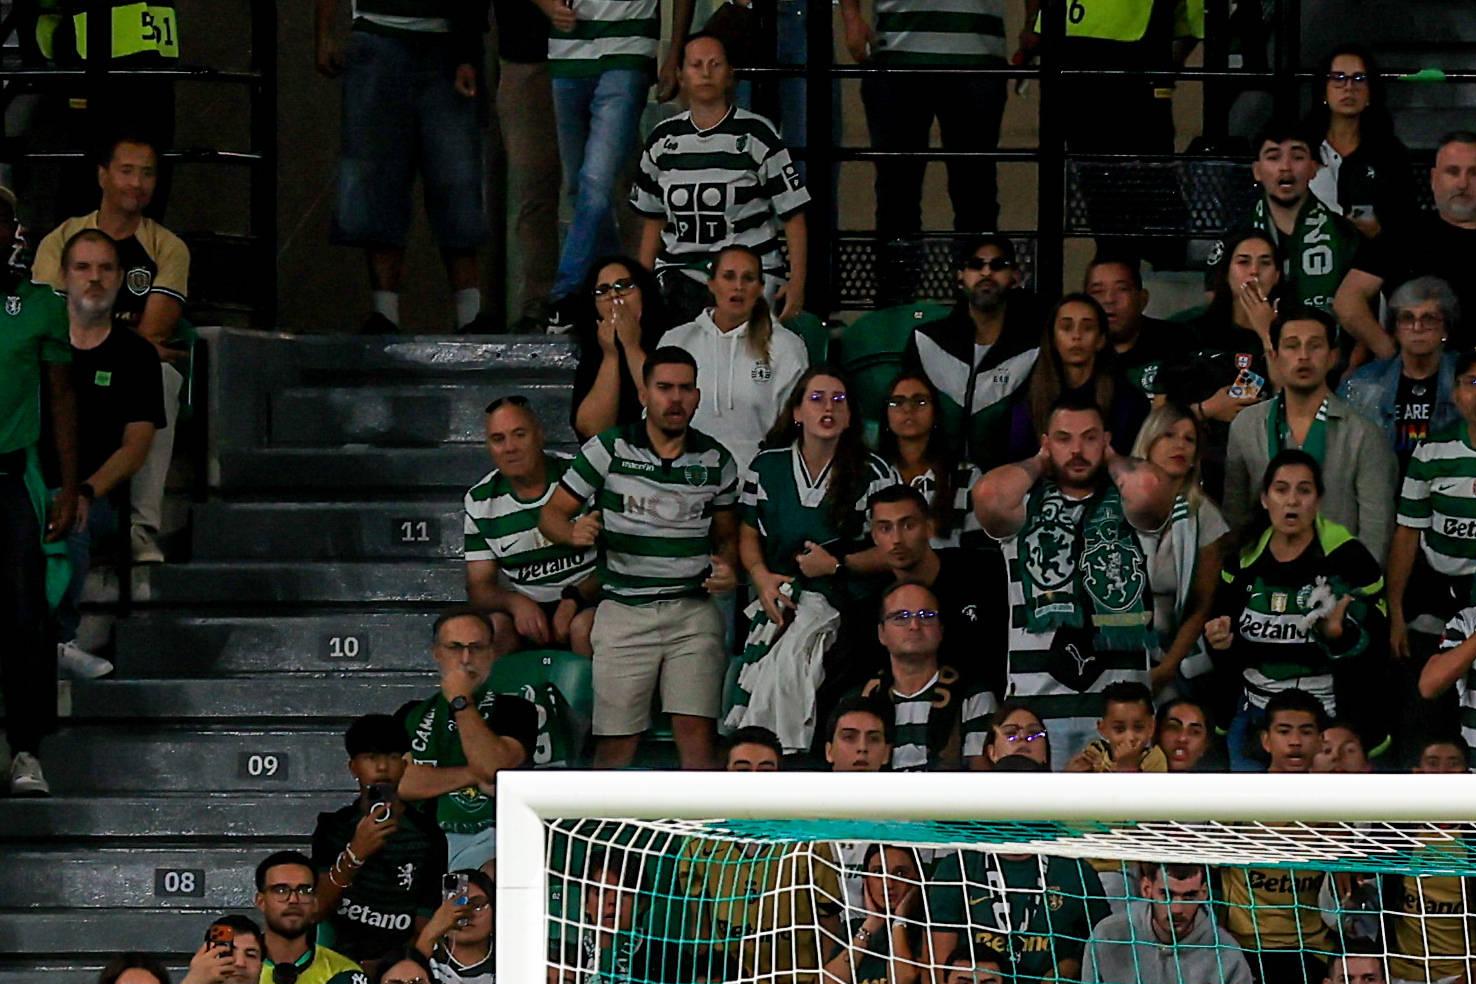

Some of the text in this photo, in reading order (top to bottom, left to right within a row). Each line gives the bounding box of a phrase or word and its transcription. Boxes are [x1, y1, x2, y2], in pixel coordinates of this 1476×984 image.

[1404, 404, 1430, 421] ARE
[401, 520, 430, 542] 11
[1240, 611, 1305, 643] Betan
[329, 636, 359, 658] 10
[247, 754, 279, 777] 09
[164, 872, 196, 893] 08
[336, 897, 412, 931] Betano
